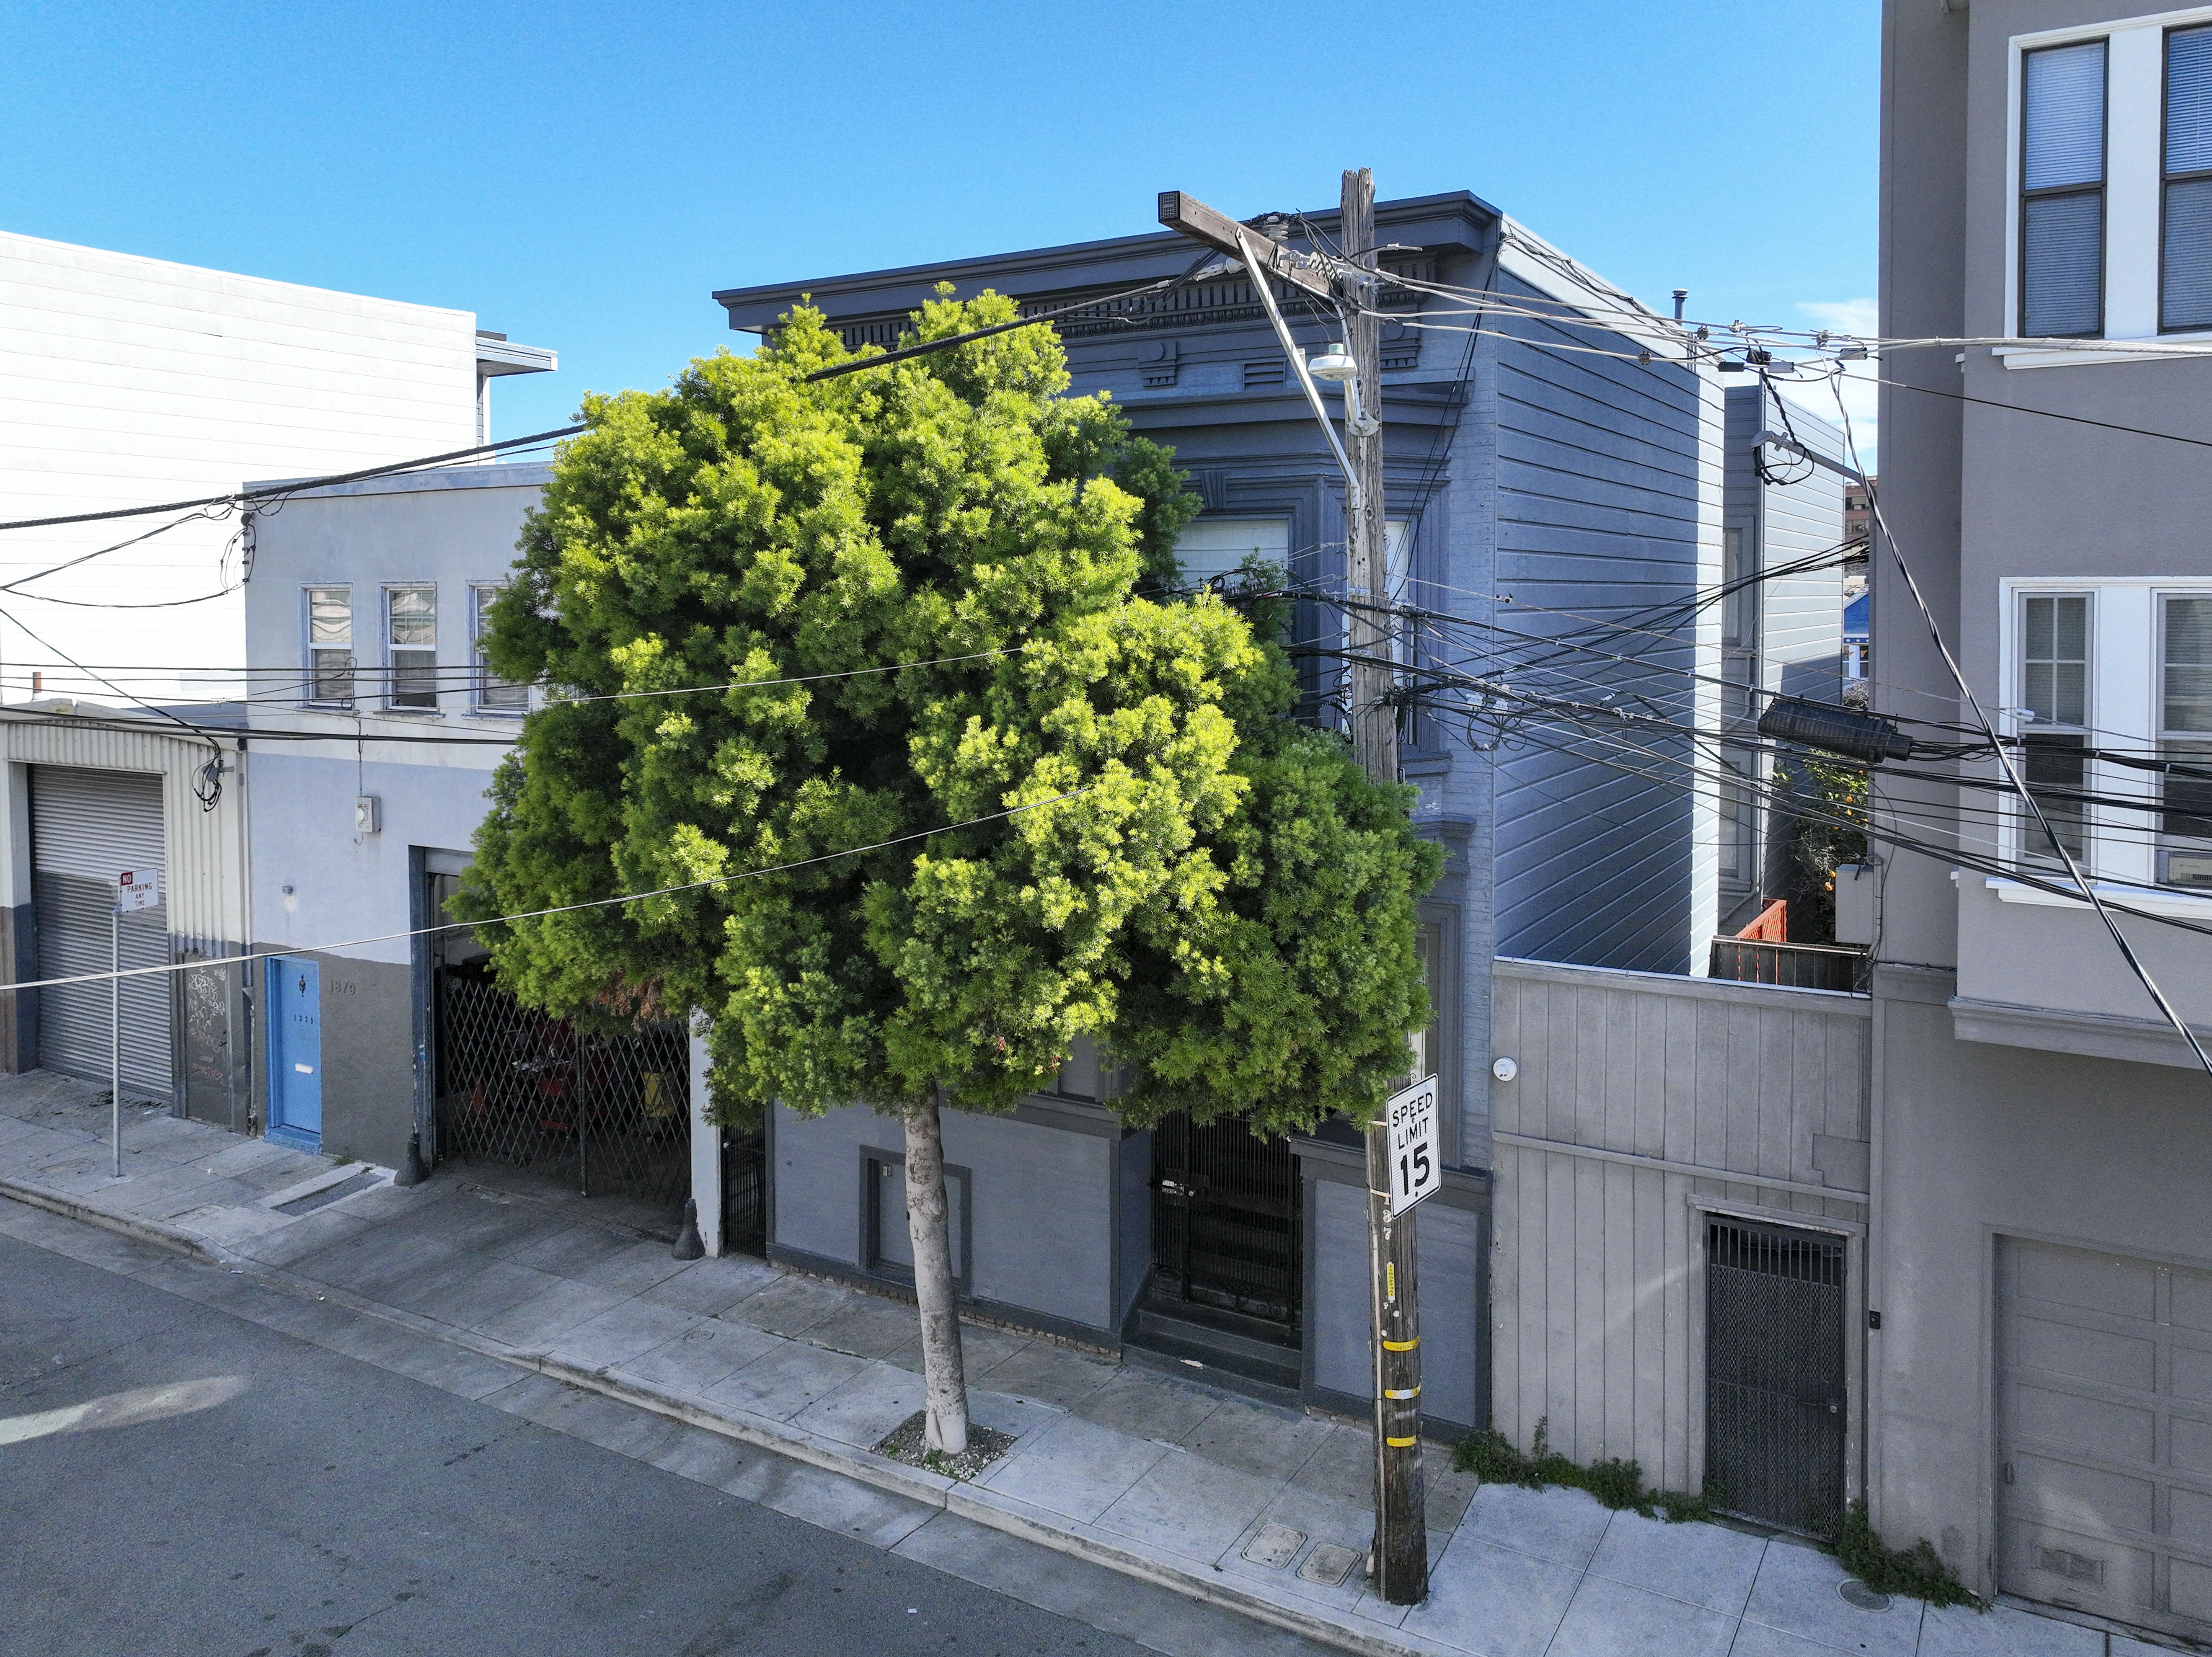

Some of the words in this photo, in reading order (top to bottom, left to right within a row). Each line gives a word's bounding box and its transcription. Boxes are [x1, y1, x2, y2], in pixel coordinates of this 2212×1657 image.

[123, 874, 132, 884] NO
[127, 882, 152, 893] PARKING
[331, 979, 356, 995] 1379
[1393, 1092, 1433, 1127] SPEED
[1398, 1117, 1429, 1150] LIMIT
[1401, 1141, 1430, 1196] 15
